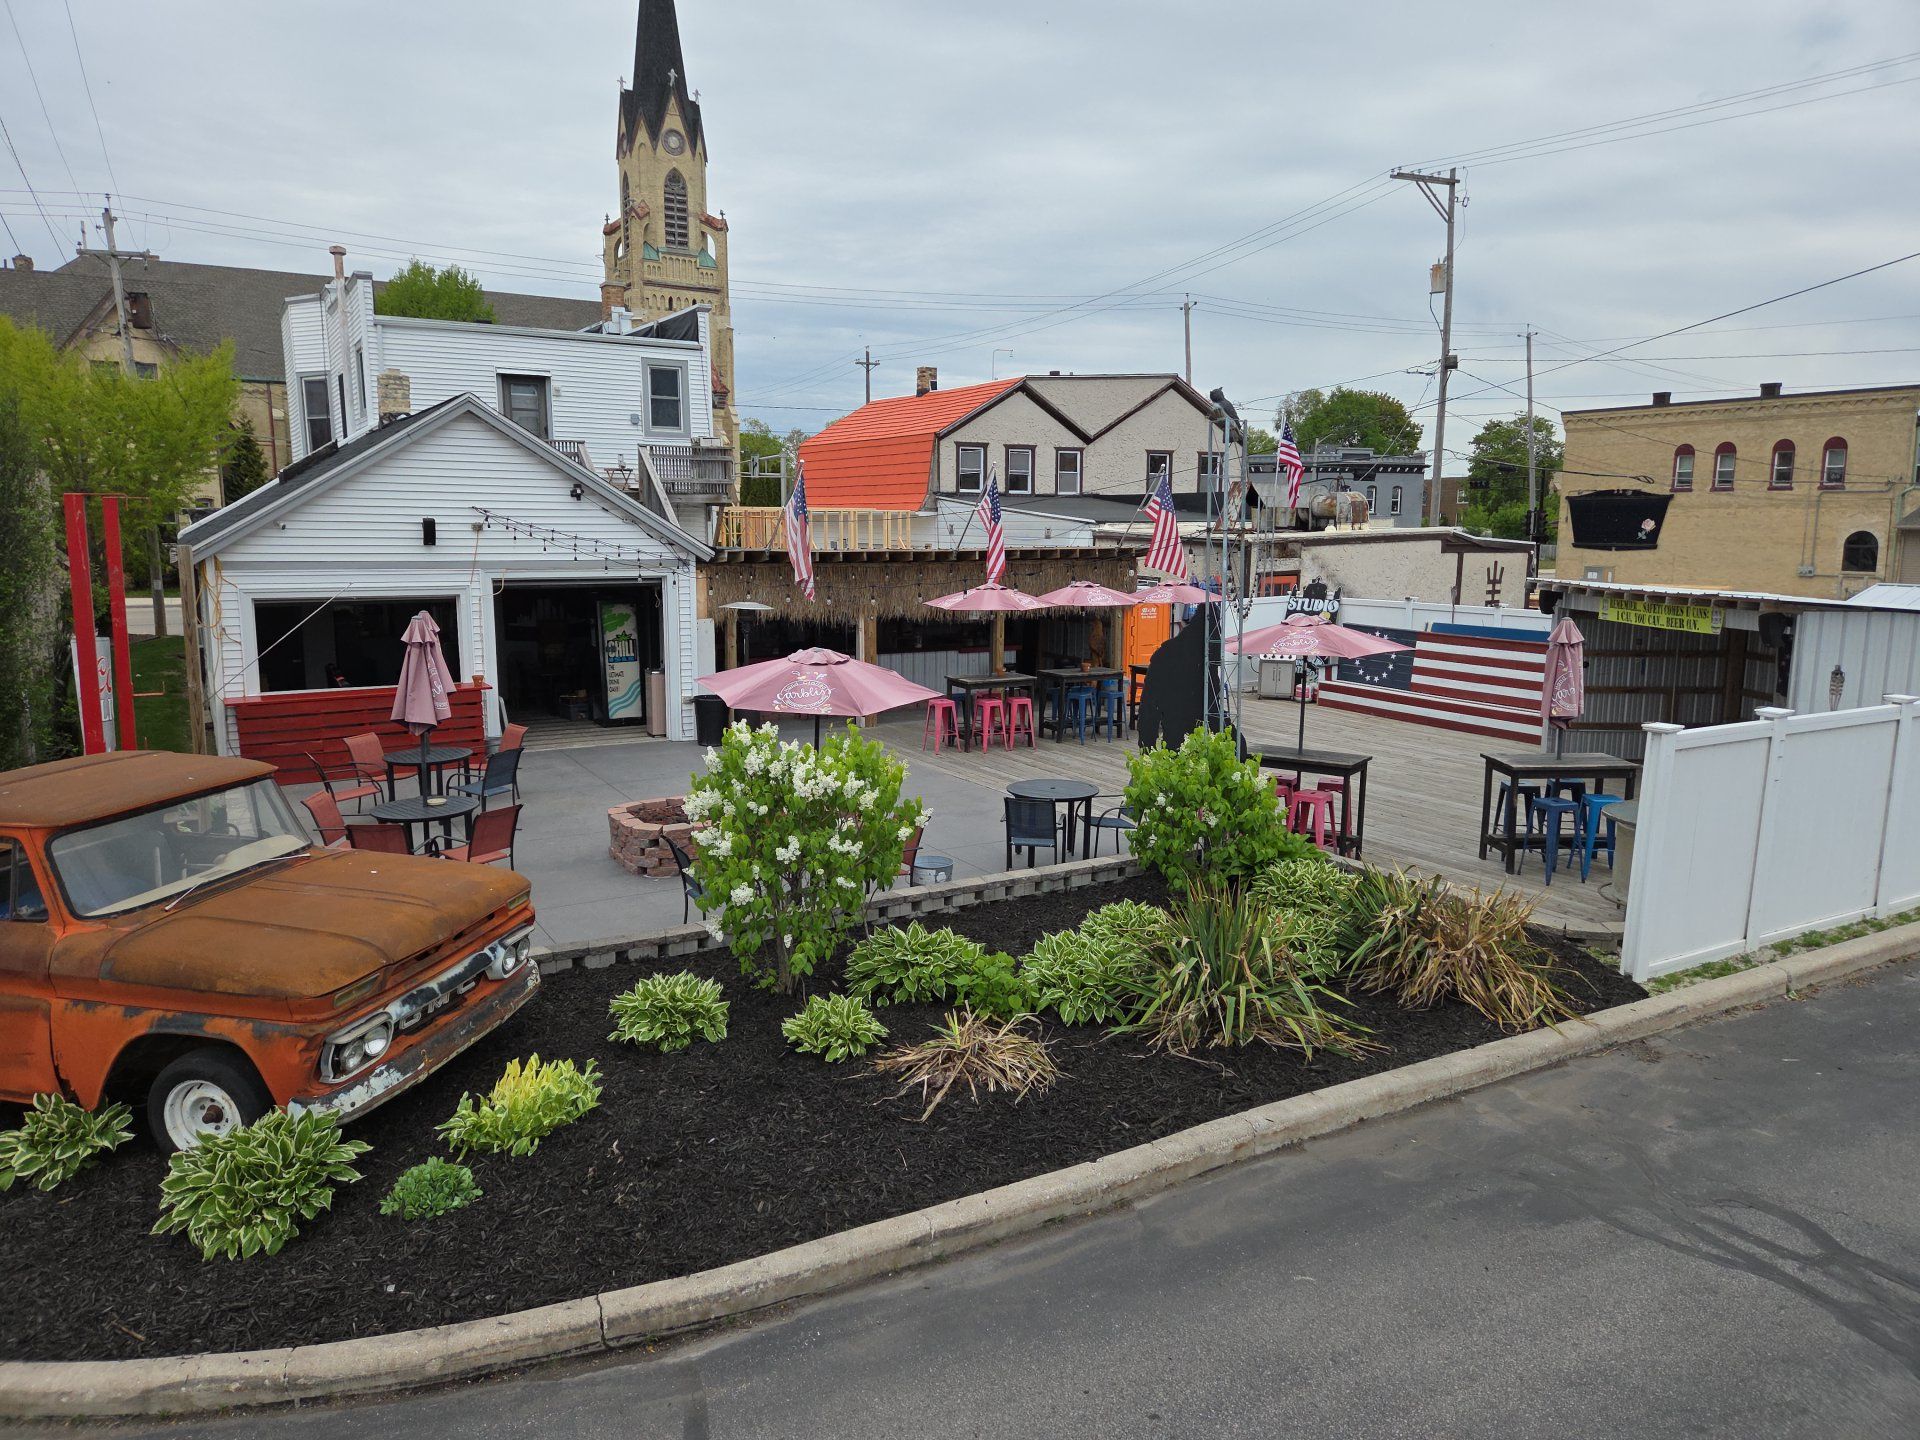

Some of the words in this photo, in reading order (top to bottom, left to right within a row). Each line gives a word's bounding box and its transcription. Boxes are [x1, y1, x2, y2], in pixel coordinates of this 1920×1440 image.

[1287, 597, 1340, 612] STUDIO
[1634, 612, 1645, 625] YOU
[1666, 616, 1685, 629] BEER
[608, 640, 635, 657] CHILL
[399, 980, 477, 1030] GMC
